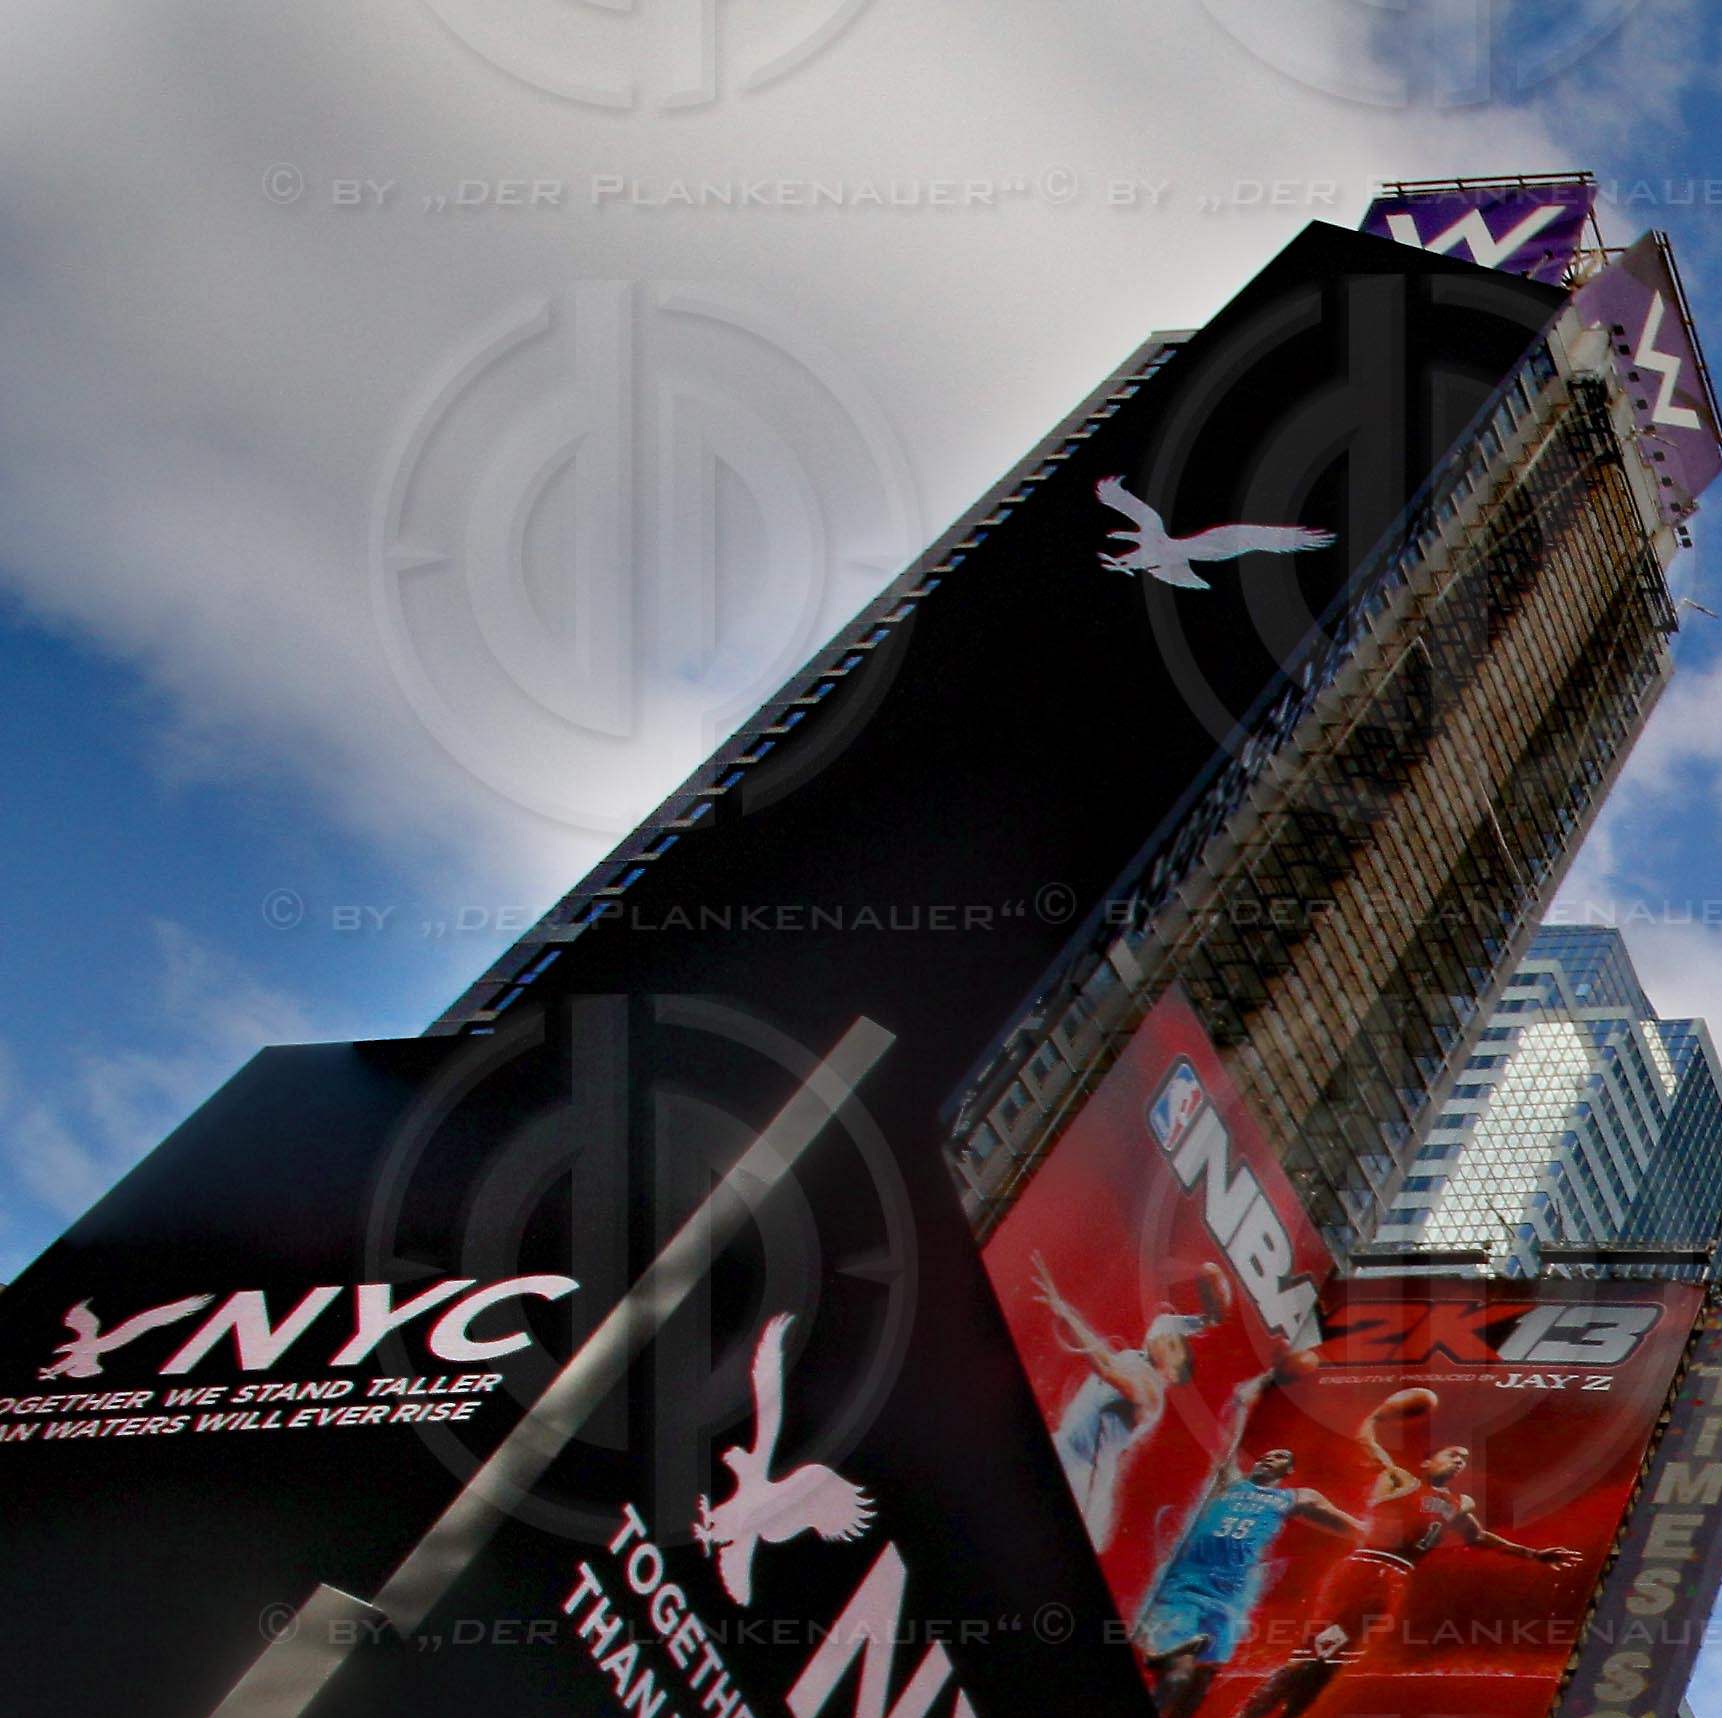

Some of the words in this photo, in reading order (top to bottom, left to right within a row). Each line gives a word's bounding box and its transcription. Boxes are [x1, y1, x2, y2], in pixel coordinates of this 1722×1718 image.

[1172, 1101, 1324, 1350] NBA
[158, 1273, 581, 1375] NYC
[163, 1386, 229, 1407] WE
[230, 1378, 355, 1403] STAND
[365, 1372, 503, 1397] TALLER
[1495, 1372, 1580, 1391] JAY
[1581, 1373, 1614, 1393] Z
[42, 1413, 192, 1440] WATERS
[195, 1409, 284, 1433] WILL
[281, 1406, 397, 1430] EVER
[389, 1400, 483, 1424] RISE
